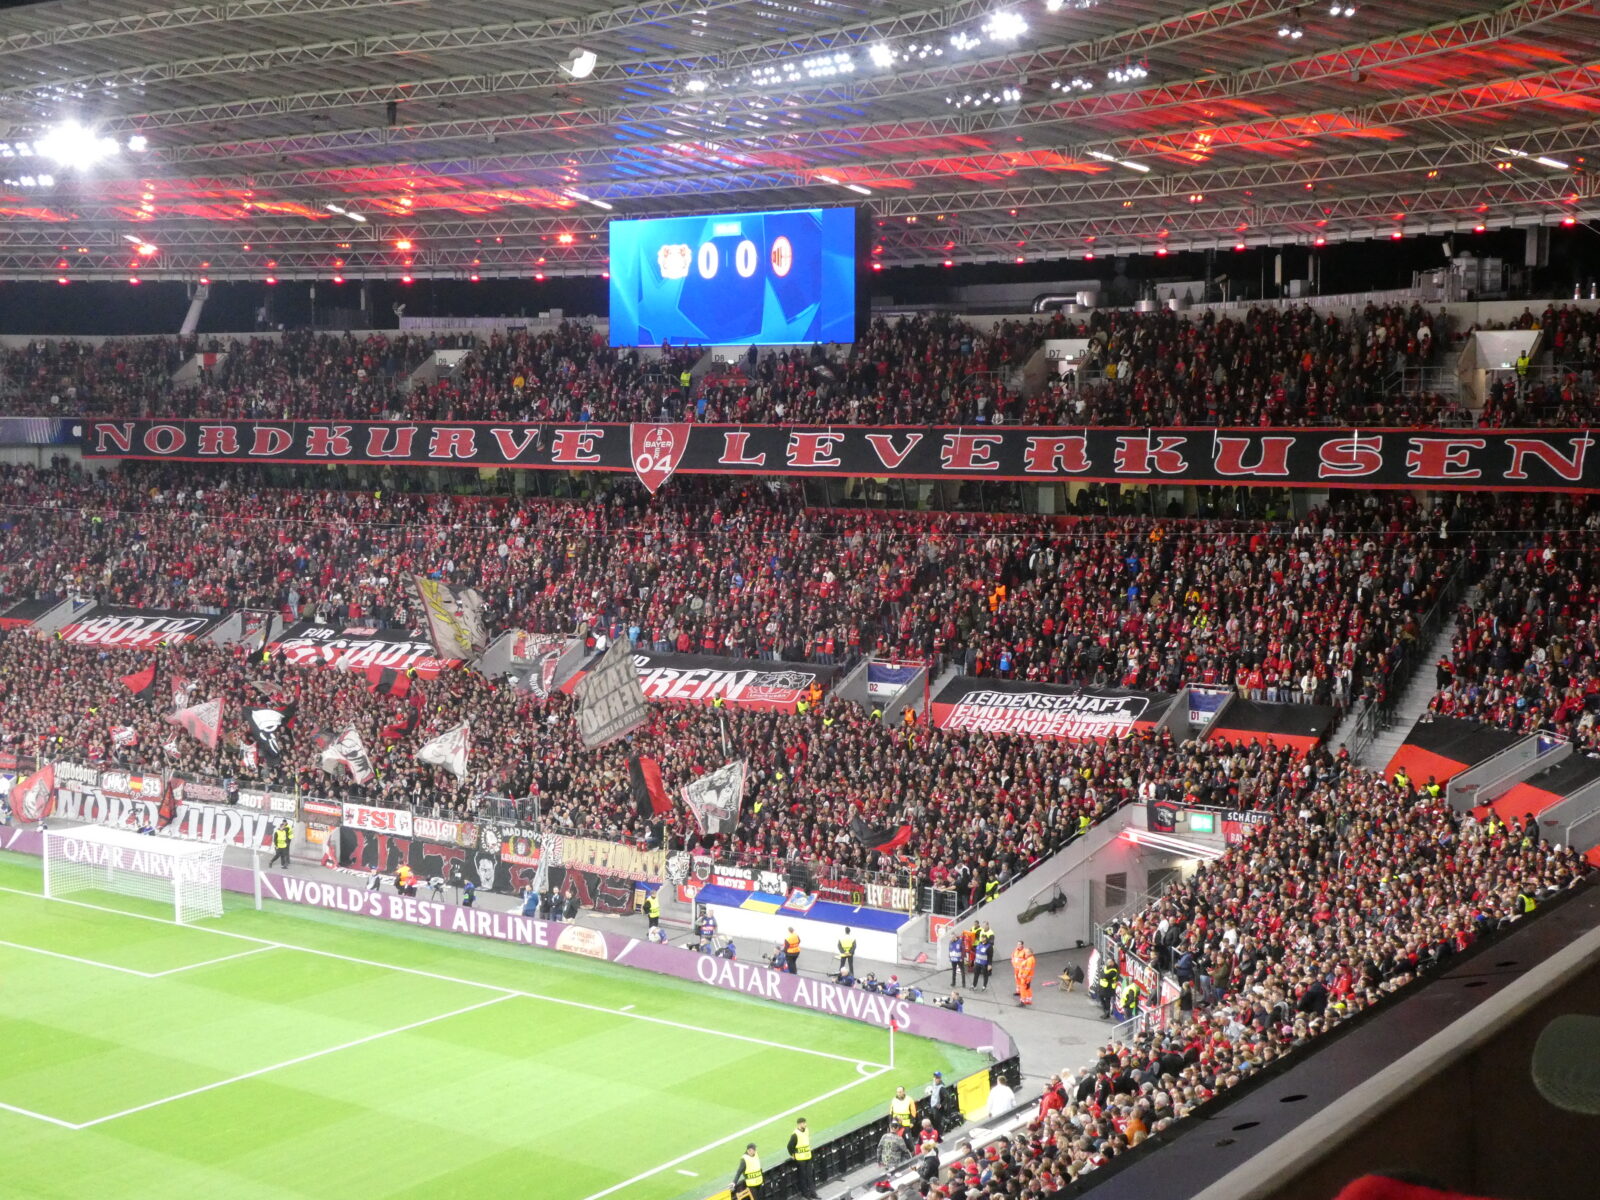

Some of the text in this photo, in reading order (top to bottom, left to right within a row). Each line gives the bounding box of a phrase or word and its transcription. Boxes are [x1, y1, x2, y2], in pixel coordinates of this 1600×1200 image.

[698, 240, 757, 279] 0 0
[94, 423, 1596, 481] NORDKURVE LEVERKUSEN
[635, 453, 672, 474] 04
[300, 627, 335, 639] FÜR
[318, 641, 432, 670] STADT
[869, 684, 879, 692] D2
[964, 692, 1131, 712] LEIDENSCHAFT
[955, 704, 1085, 722] EMOTIONEN
[1191, 711, 1200, 721] D1
[949, 716, 1130, 737] VERBUNDENHEIT
[502, 827, 521, 837] MAD
[63, 838, 123, 869] QATAR
[713, 865, 752, 878] YOUNG
[867, 884, 884, 906] LEV
[283, 877, 383, 917] WORLD'S
[389, 895, 444, 927] BEST
[452, 904, 549, 946] AIRLINE
[697, 955, 911, 1029] QATAR AIRWAYS
